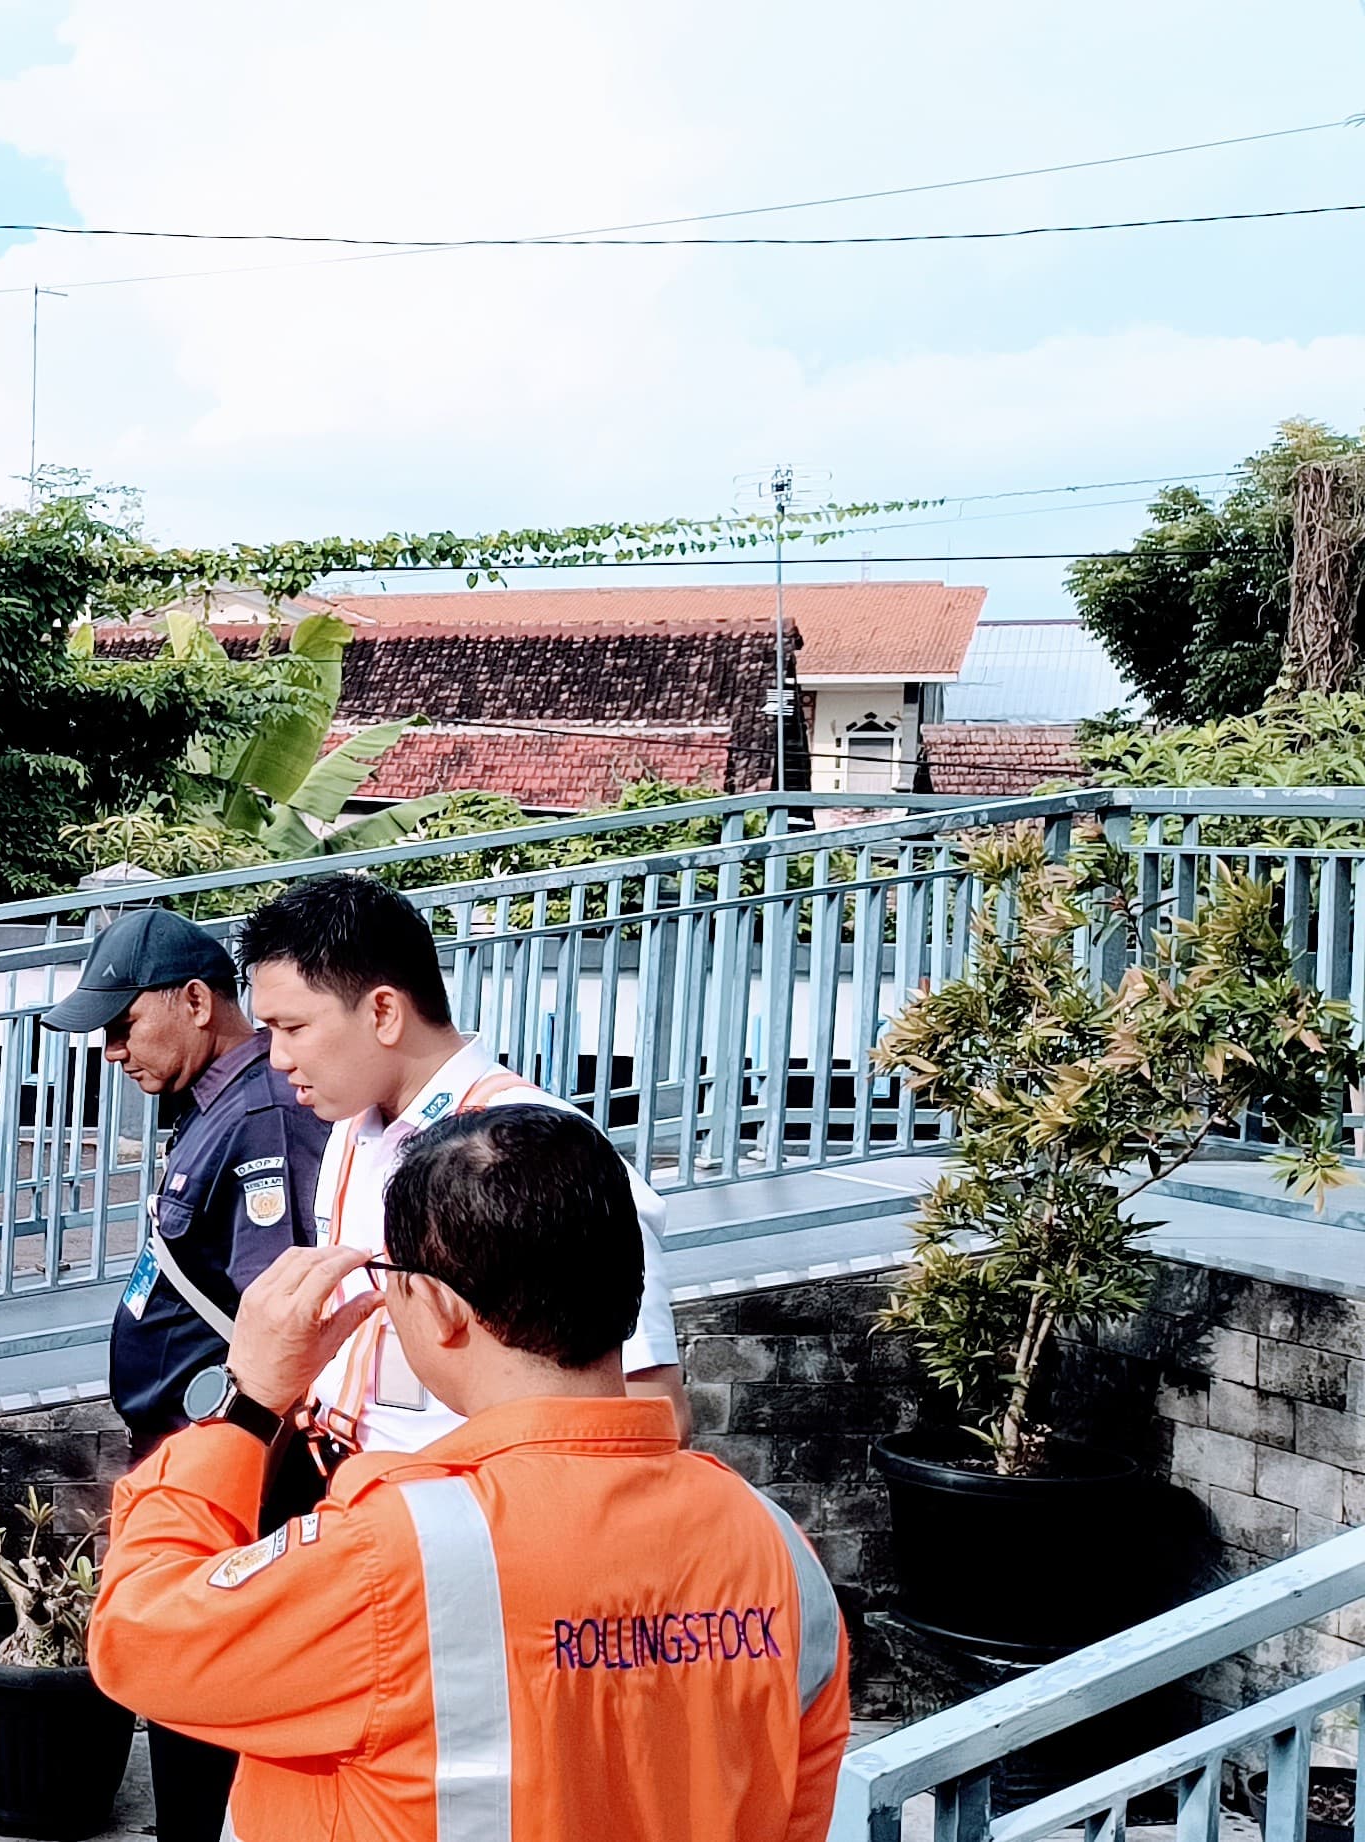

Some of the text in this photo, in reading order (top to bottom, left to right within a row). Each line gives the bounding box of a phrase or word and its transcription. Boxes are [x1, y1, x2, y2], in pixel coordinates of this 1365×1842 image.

[237, 1158, 281, 1175] DAOP 7
[554, 1606, 782, 1670] ROLLINGSTOCK
